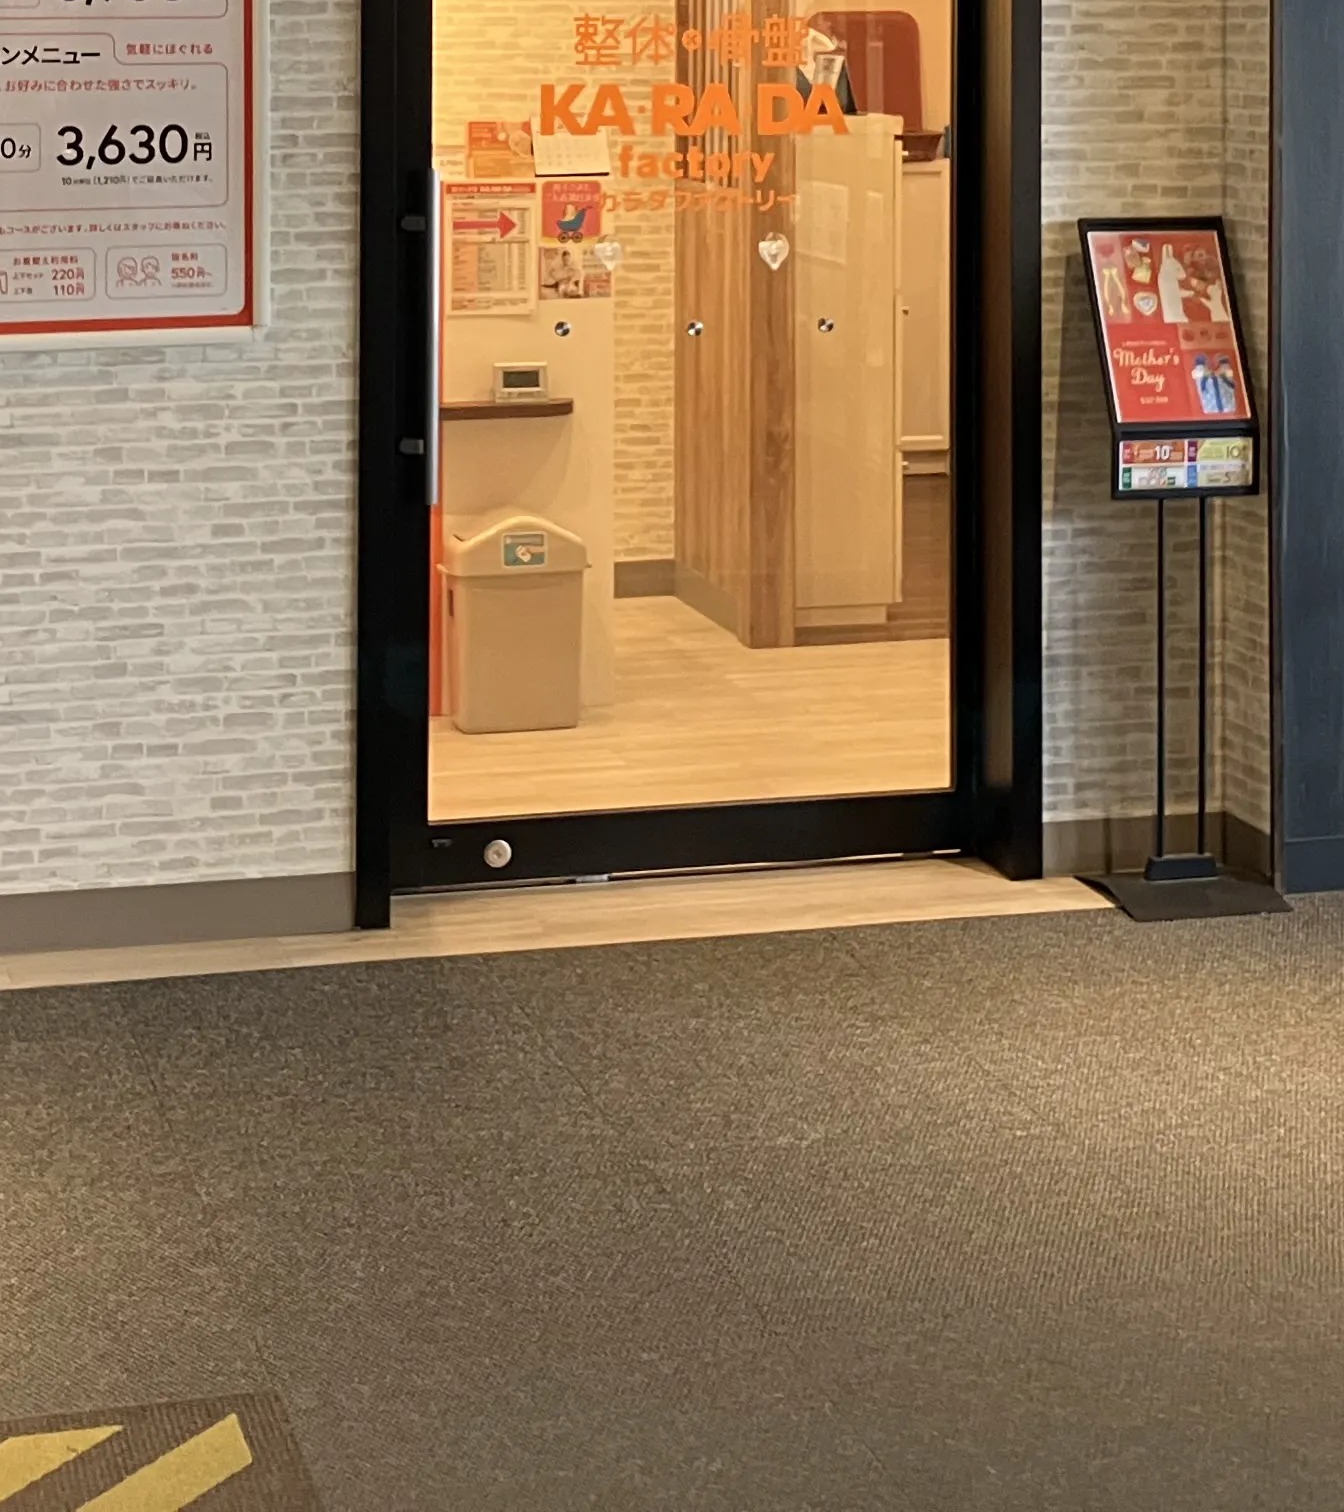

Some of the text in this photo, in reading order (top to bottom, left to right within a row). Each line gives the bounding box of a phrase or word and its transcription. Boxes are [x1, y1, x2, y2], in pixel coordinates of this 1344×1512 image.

[125, 42, 214, 57] 気軽にほぐれる
[618, 144, 776, 183] factory
[51, 267, 85, 281] 220円
[1130, 367, 1165, 393] Day
